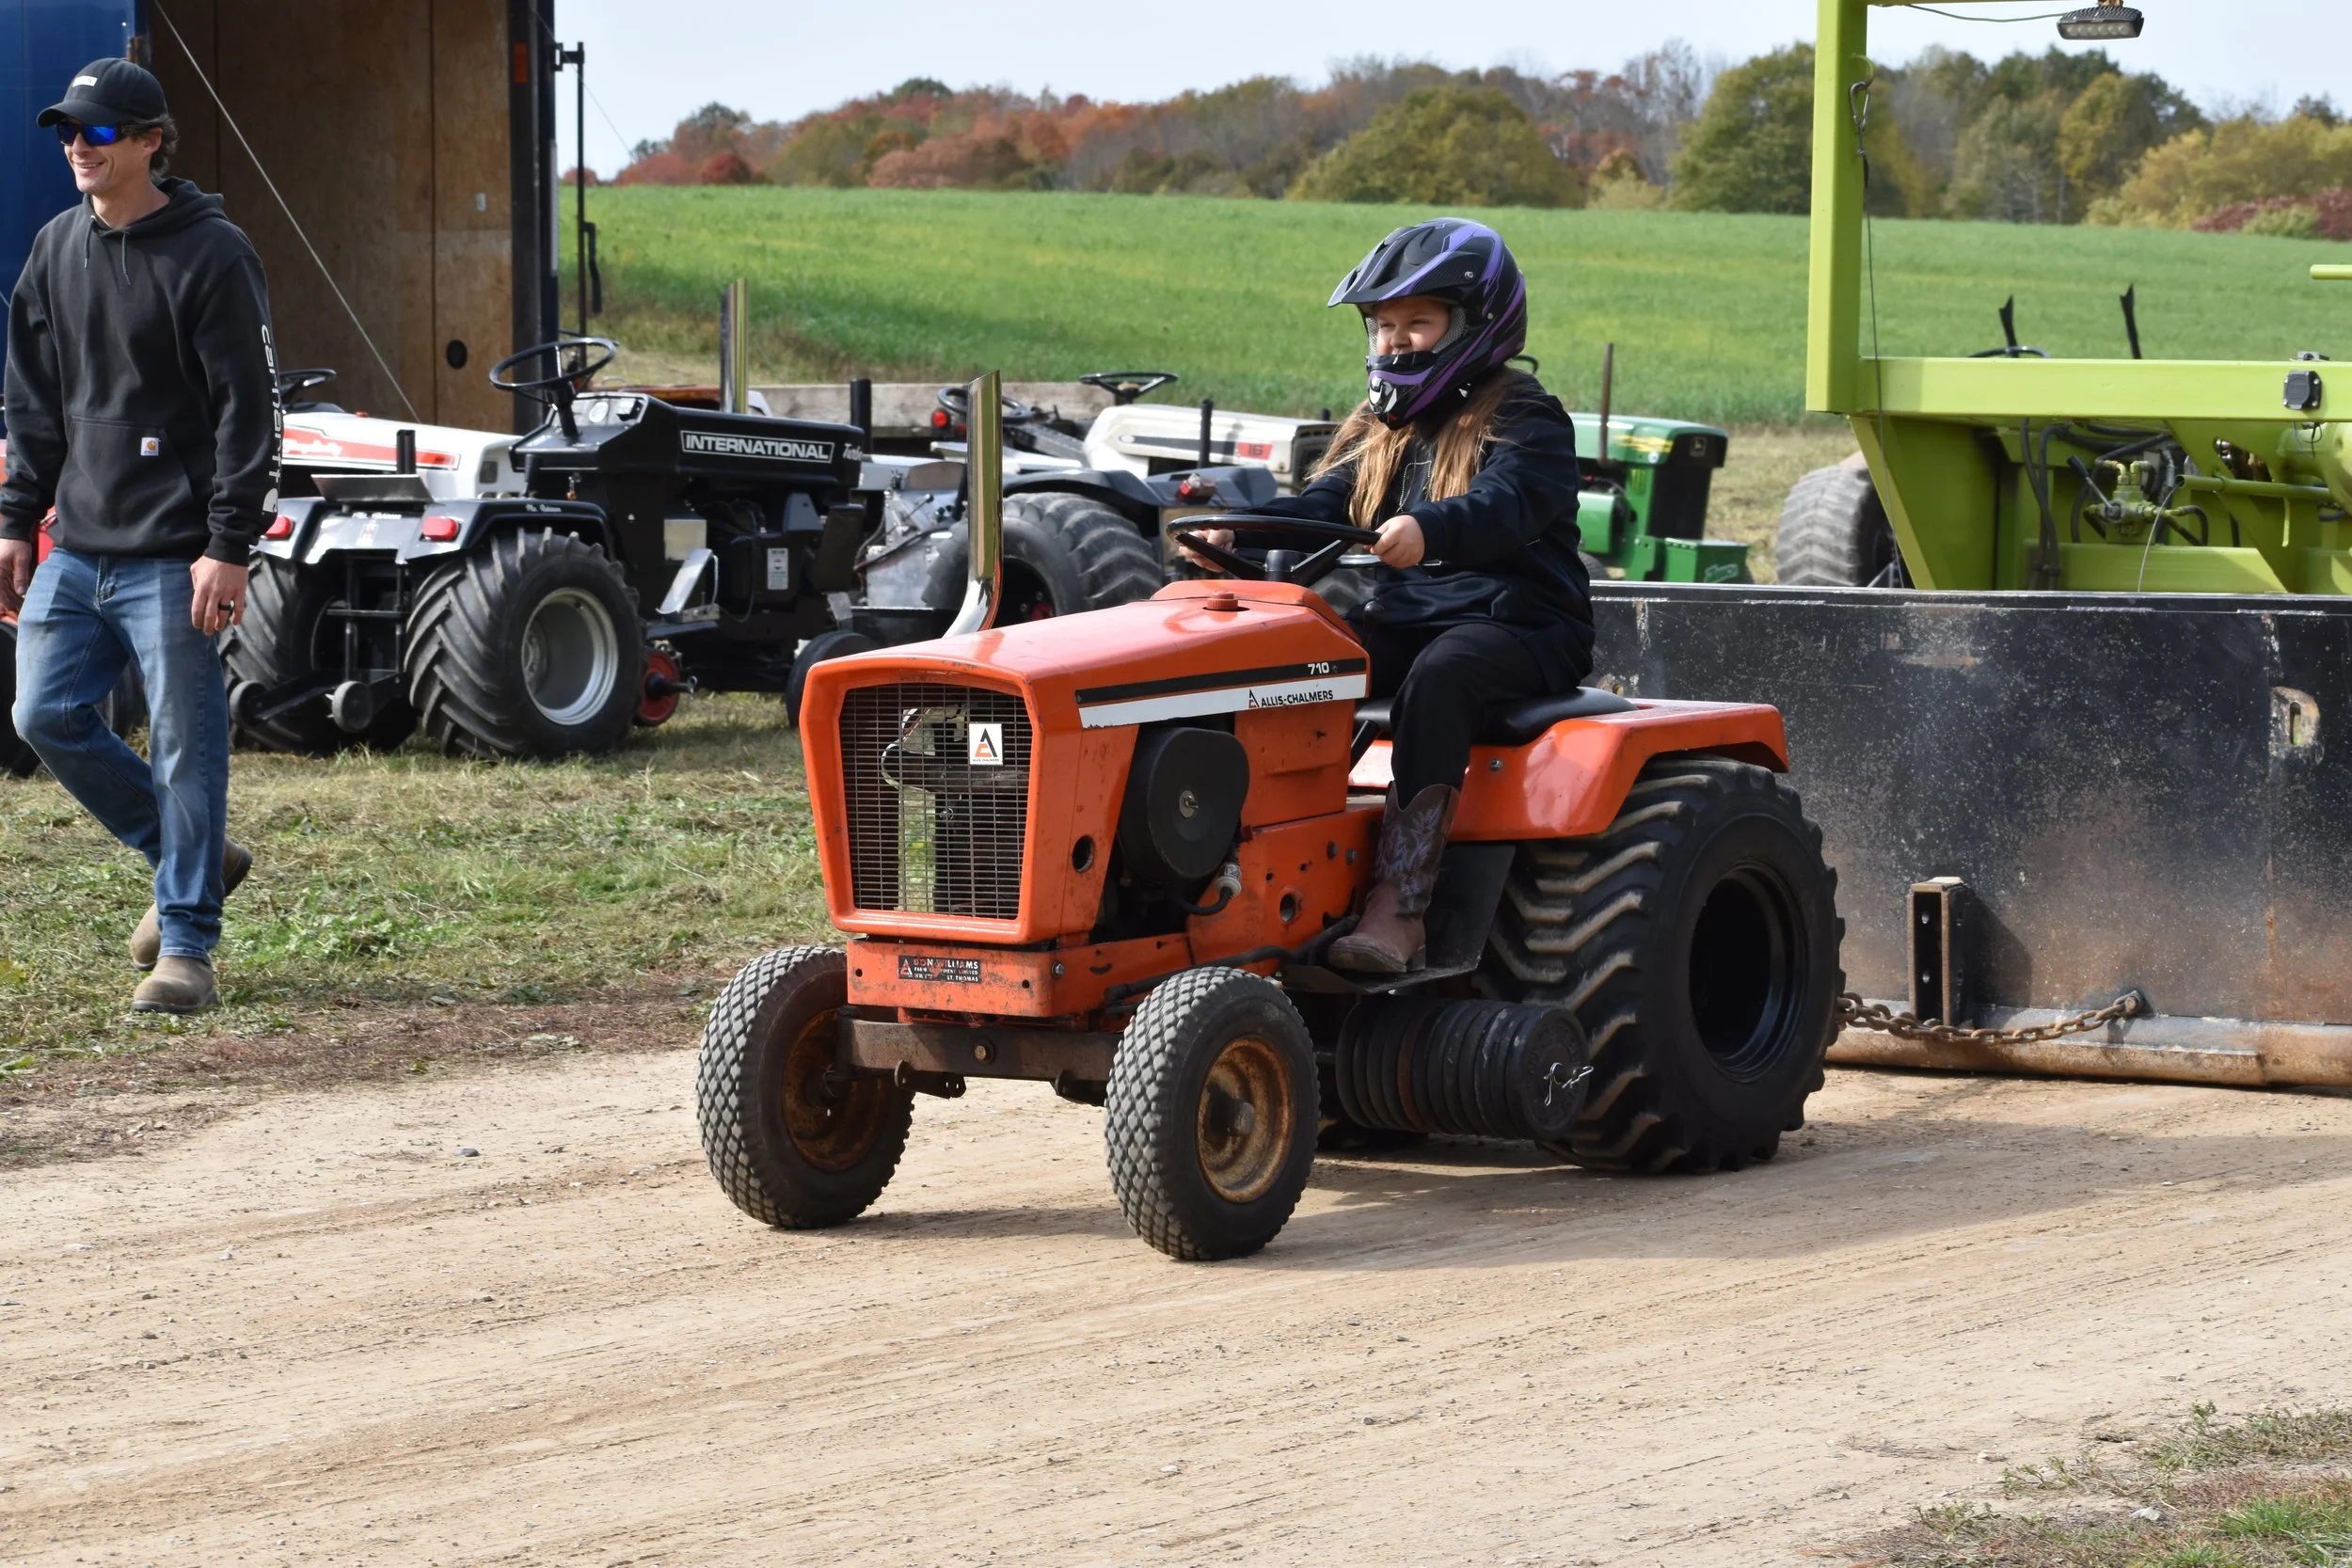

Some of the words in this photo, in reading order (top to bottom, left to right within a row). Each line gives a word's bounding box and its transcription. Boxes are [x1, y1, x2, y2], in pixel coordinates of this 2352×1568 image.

[686, 434, 829, 460] INTERNATIONAL
[1248, 443, 1263, 456] 16
[1308, 661, 1330, 675] 710
[1261, 689, 1334, 708] ALLIS-CHALMERS
